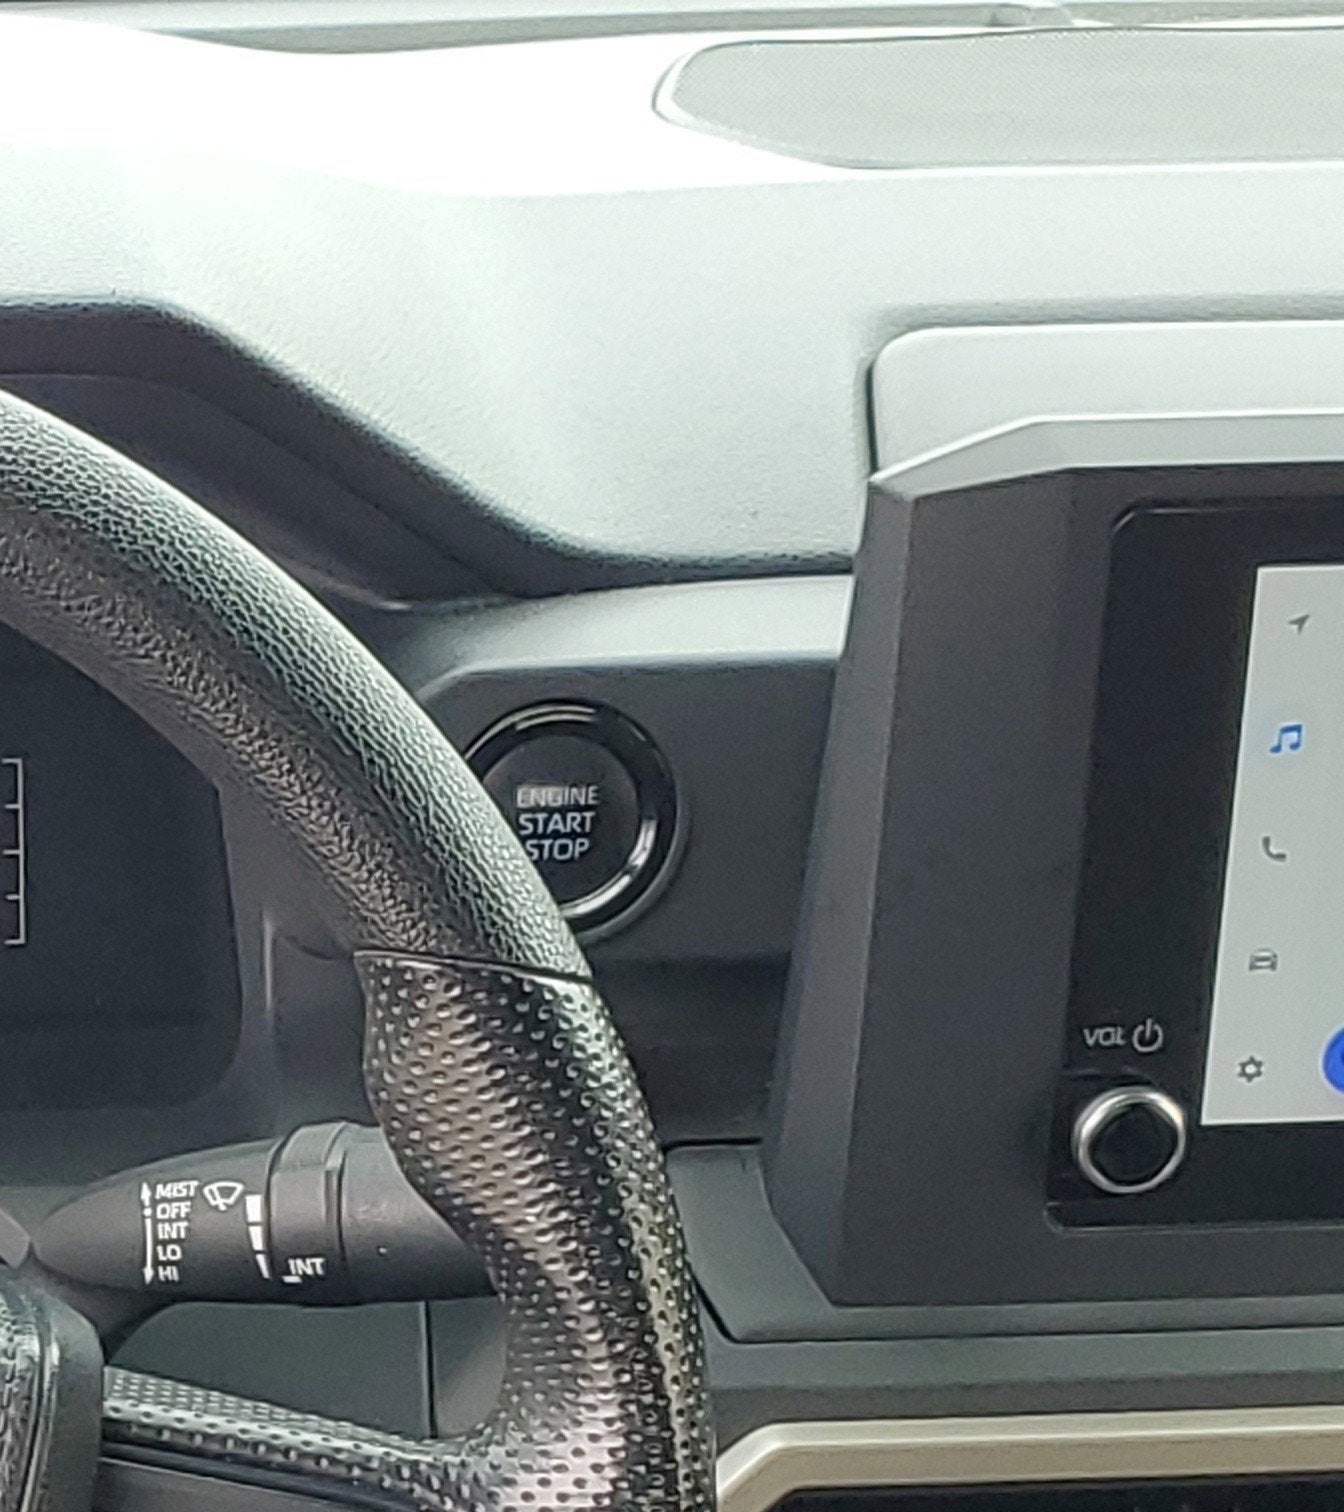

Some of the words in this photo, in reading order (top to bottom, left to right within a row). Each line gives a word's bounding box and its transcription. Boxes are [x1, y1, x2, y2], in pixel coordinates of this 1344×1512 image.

[515, 785, 600, 809] ENGINE
[517, 811, 597, 835] START
[525, 838, 590, 861] STOP
[1082, 1026, 1127, 1047] VOL
[155, 1180, 200, 1200] MIST
[156, 1201, 193, 1220] OFF
[158, 1222, 189, 1239] INT
[156, 1244, 183, 1262] LO
[158, 1264, 180, 1282] HI
[287, 1257, 327, 1276] INT
